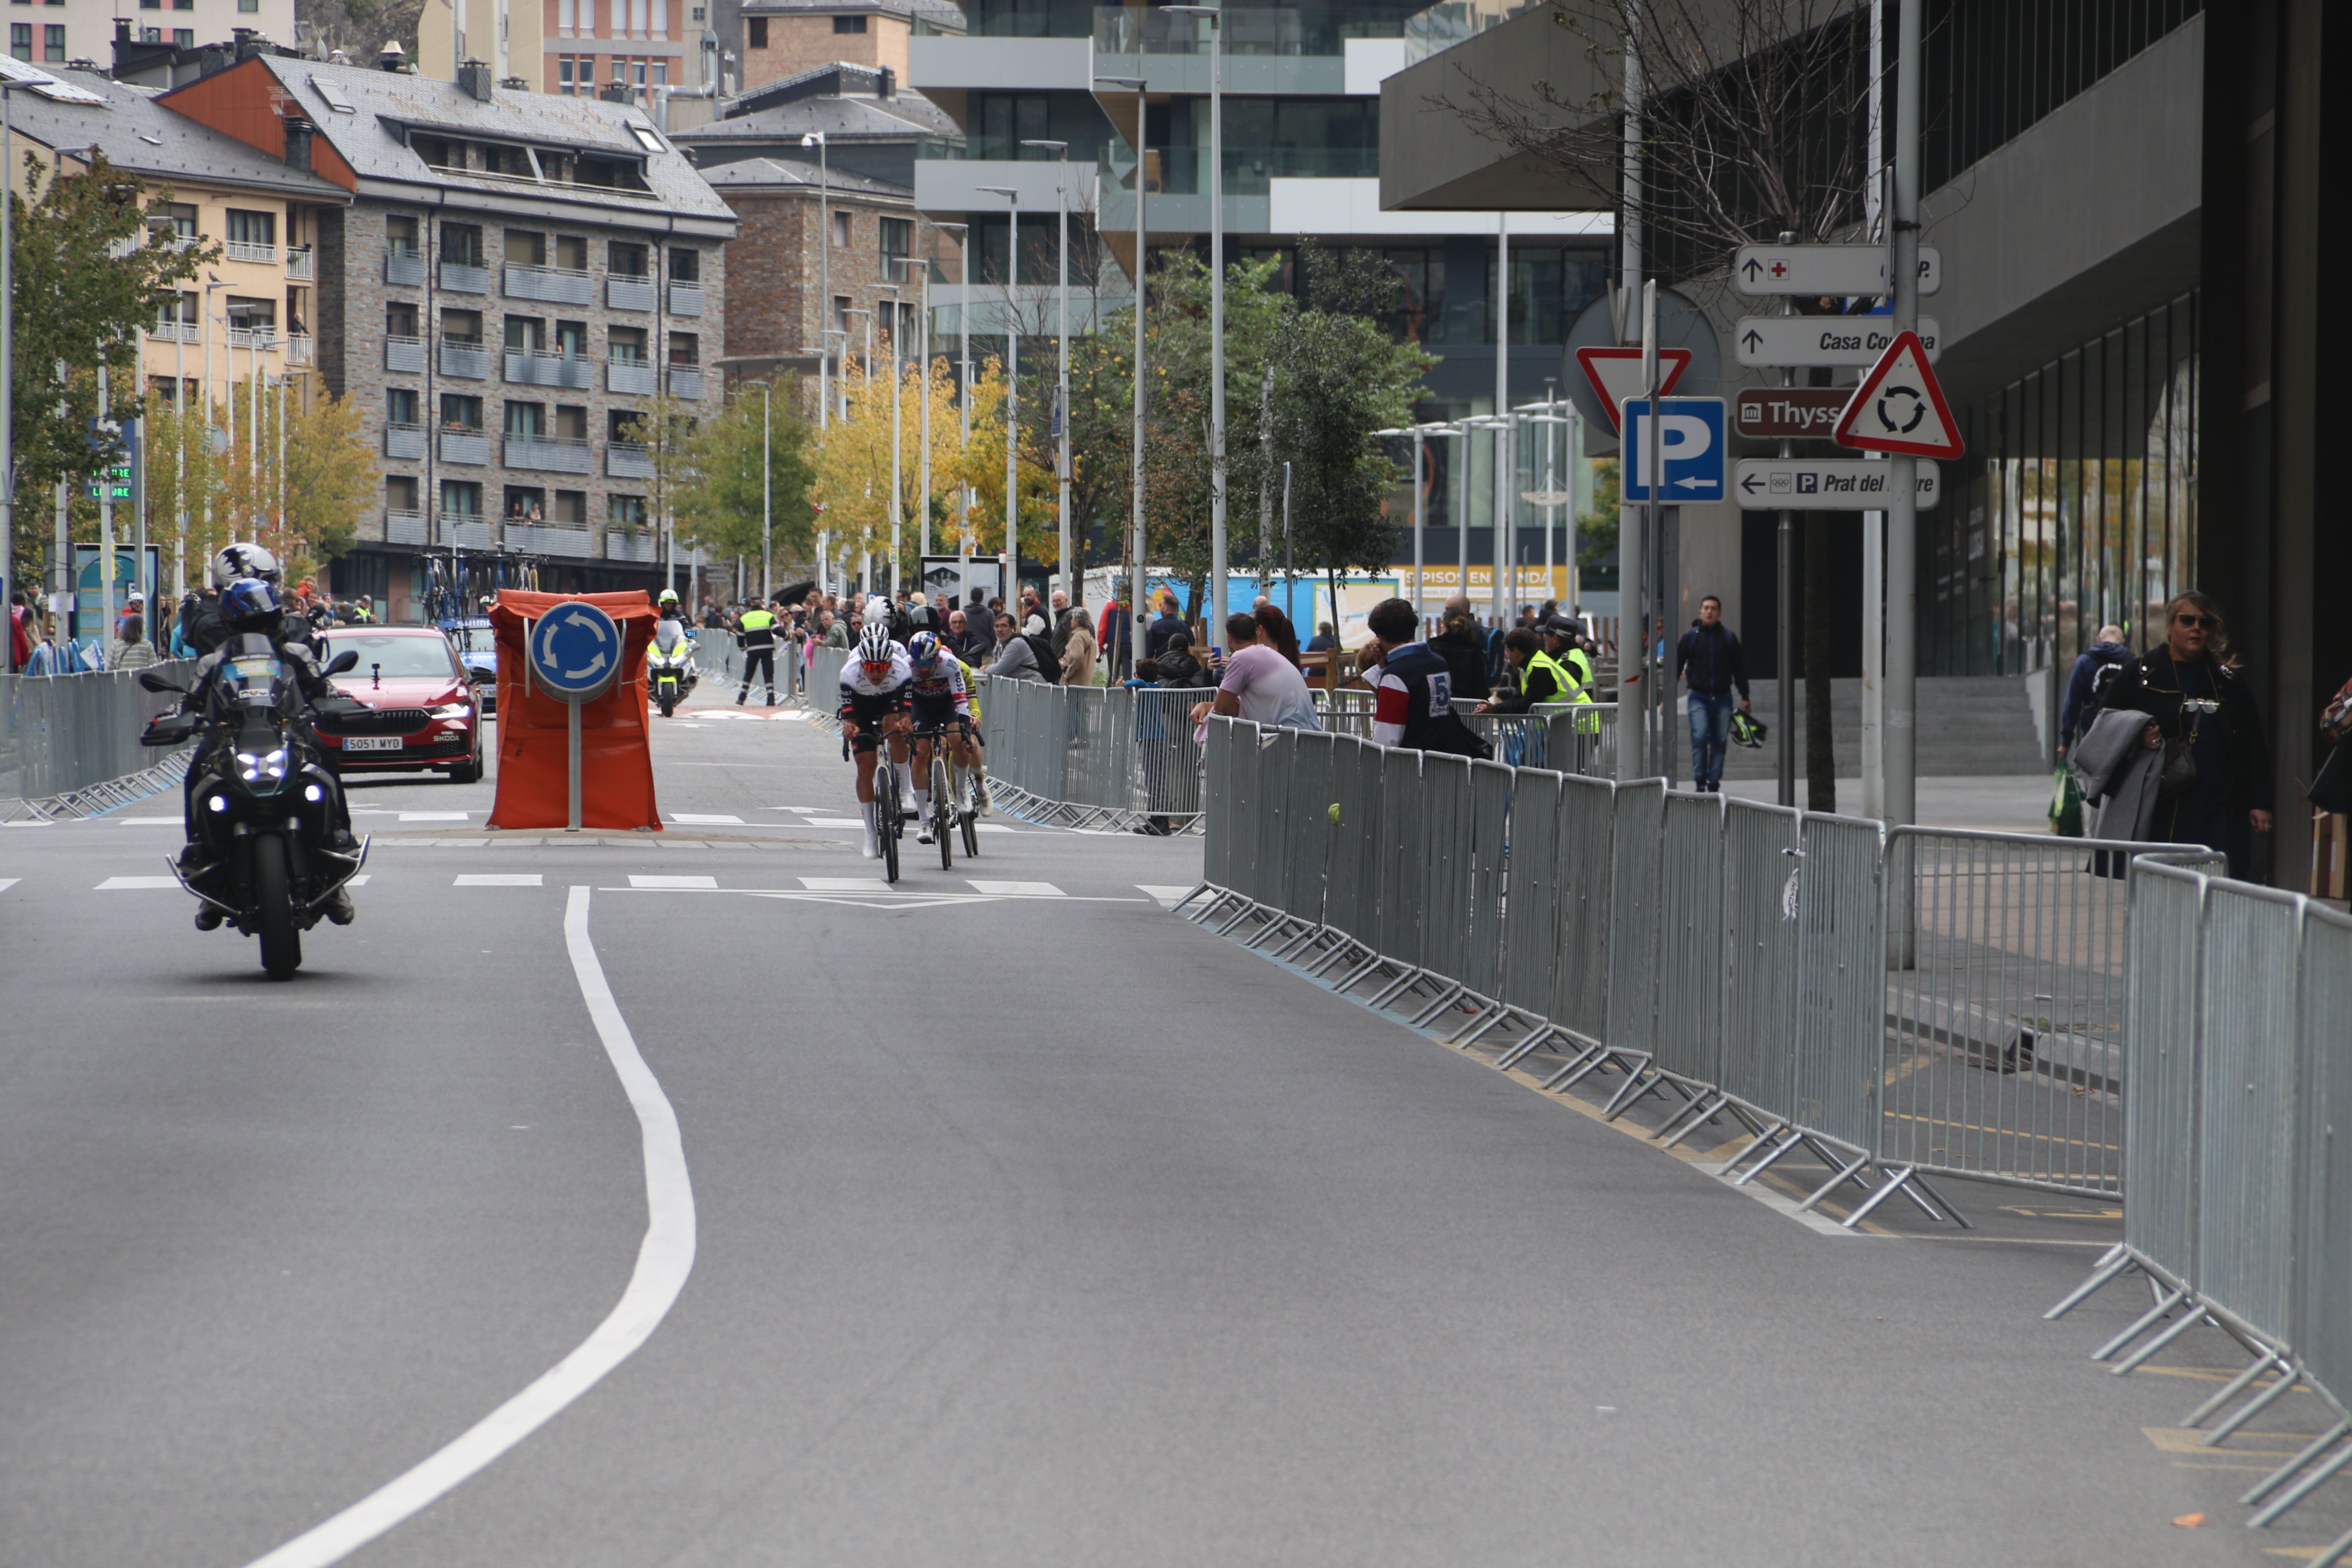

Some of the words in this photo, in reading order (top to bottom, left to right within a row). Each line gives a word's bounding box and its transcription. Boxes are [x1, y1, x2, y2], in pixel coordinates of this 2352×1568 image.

[1819, 332, 1862, 350] Casa
[1637, 415, 1711, 486] P
[1824, 475, 1857, 491] Prat
[1860, 475, 1885, 491] del
[1470, 572, 1491, 584] EN
[955, 671, 964, 692] BOSS
[1434, 676, 1449, 706] 5
[350, 739, 375, 749] 5051
